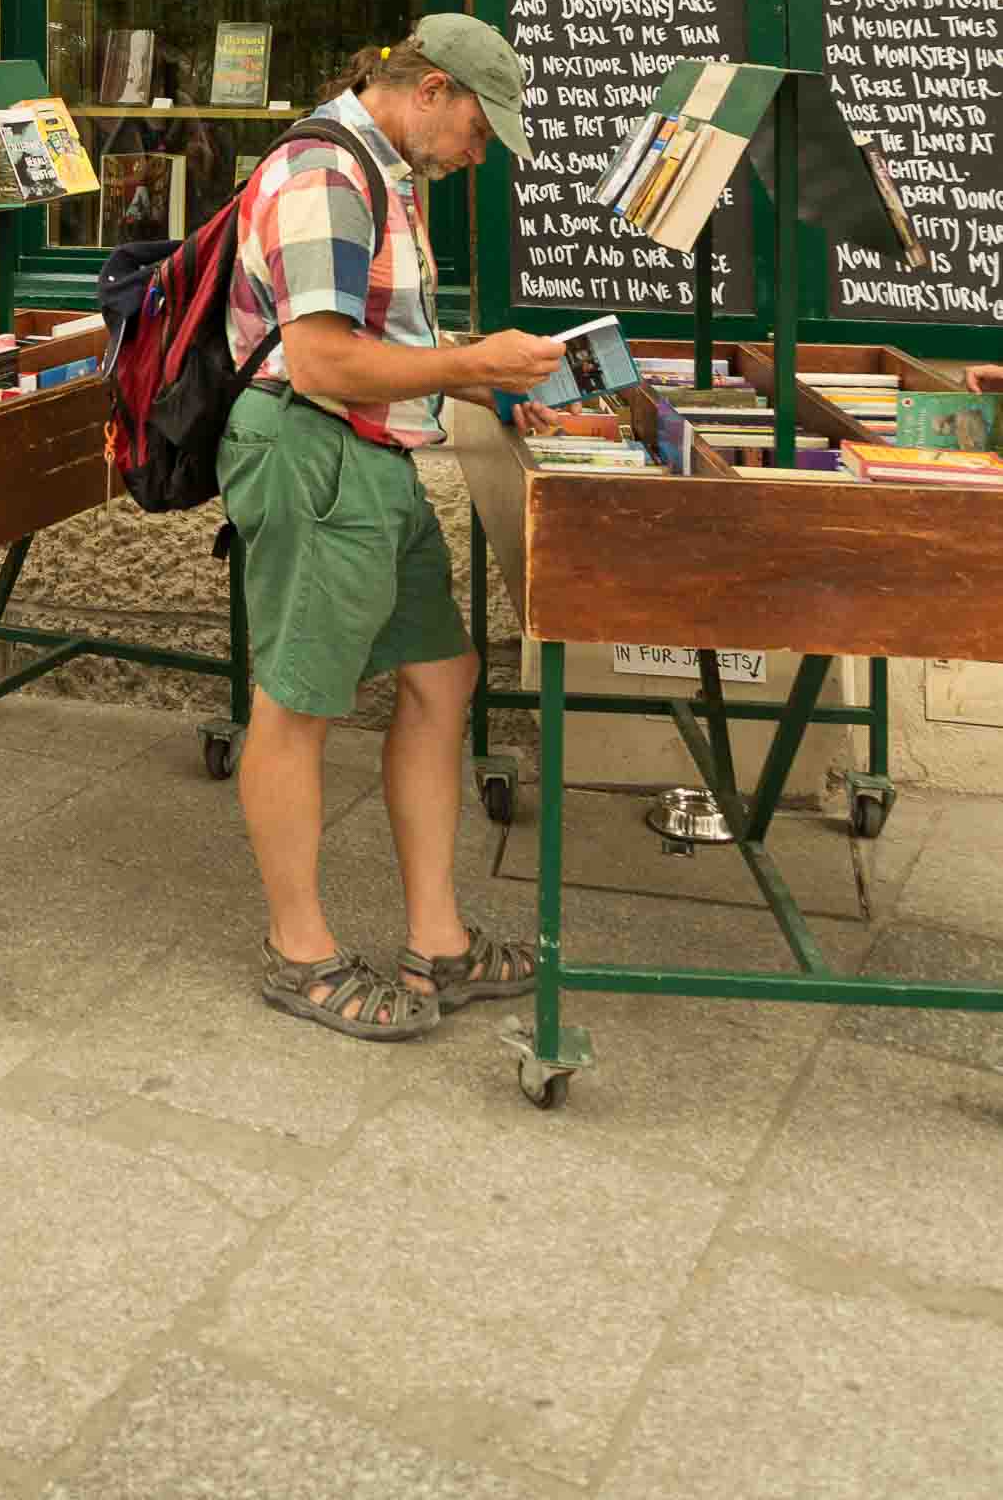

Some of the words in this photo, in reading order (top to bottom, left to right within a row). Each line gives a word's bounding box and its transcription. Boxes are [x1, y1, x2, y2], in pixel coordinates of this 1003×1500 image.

[513, 22, 555, 48] MORE
[562, 22, 611, 51] REAL
[612, 24, 635, 46] TO
[641, 24, 668, 46] ME
[674, 24, 721, 47] THAN
[825, 12, 845, 38] IN
[851, 15, 941, 40] MEDIEVAL
[939, 15, 999, 38] TIMES
[520, 271, 585, 299] READING
[590, 277, 609, 299] IT
[612, 280, 621, 301] I
[626, 278, 673, 303] HAVE
[677, 281, 726, 306] BN
[840, 278, 940, 312] DAUGHTER'S
[615, 644, 630, 662] IN
[639, 645, 676, 664] FUR
[682, 648, 752, 670] JAKETS
